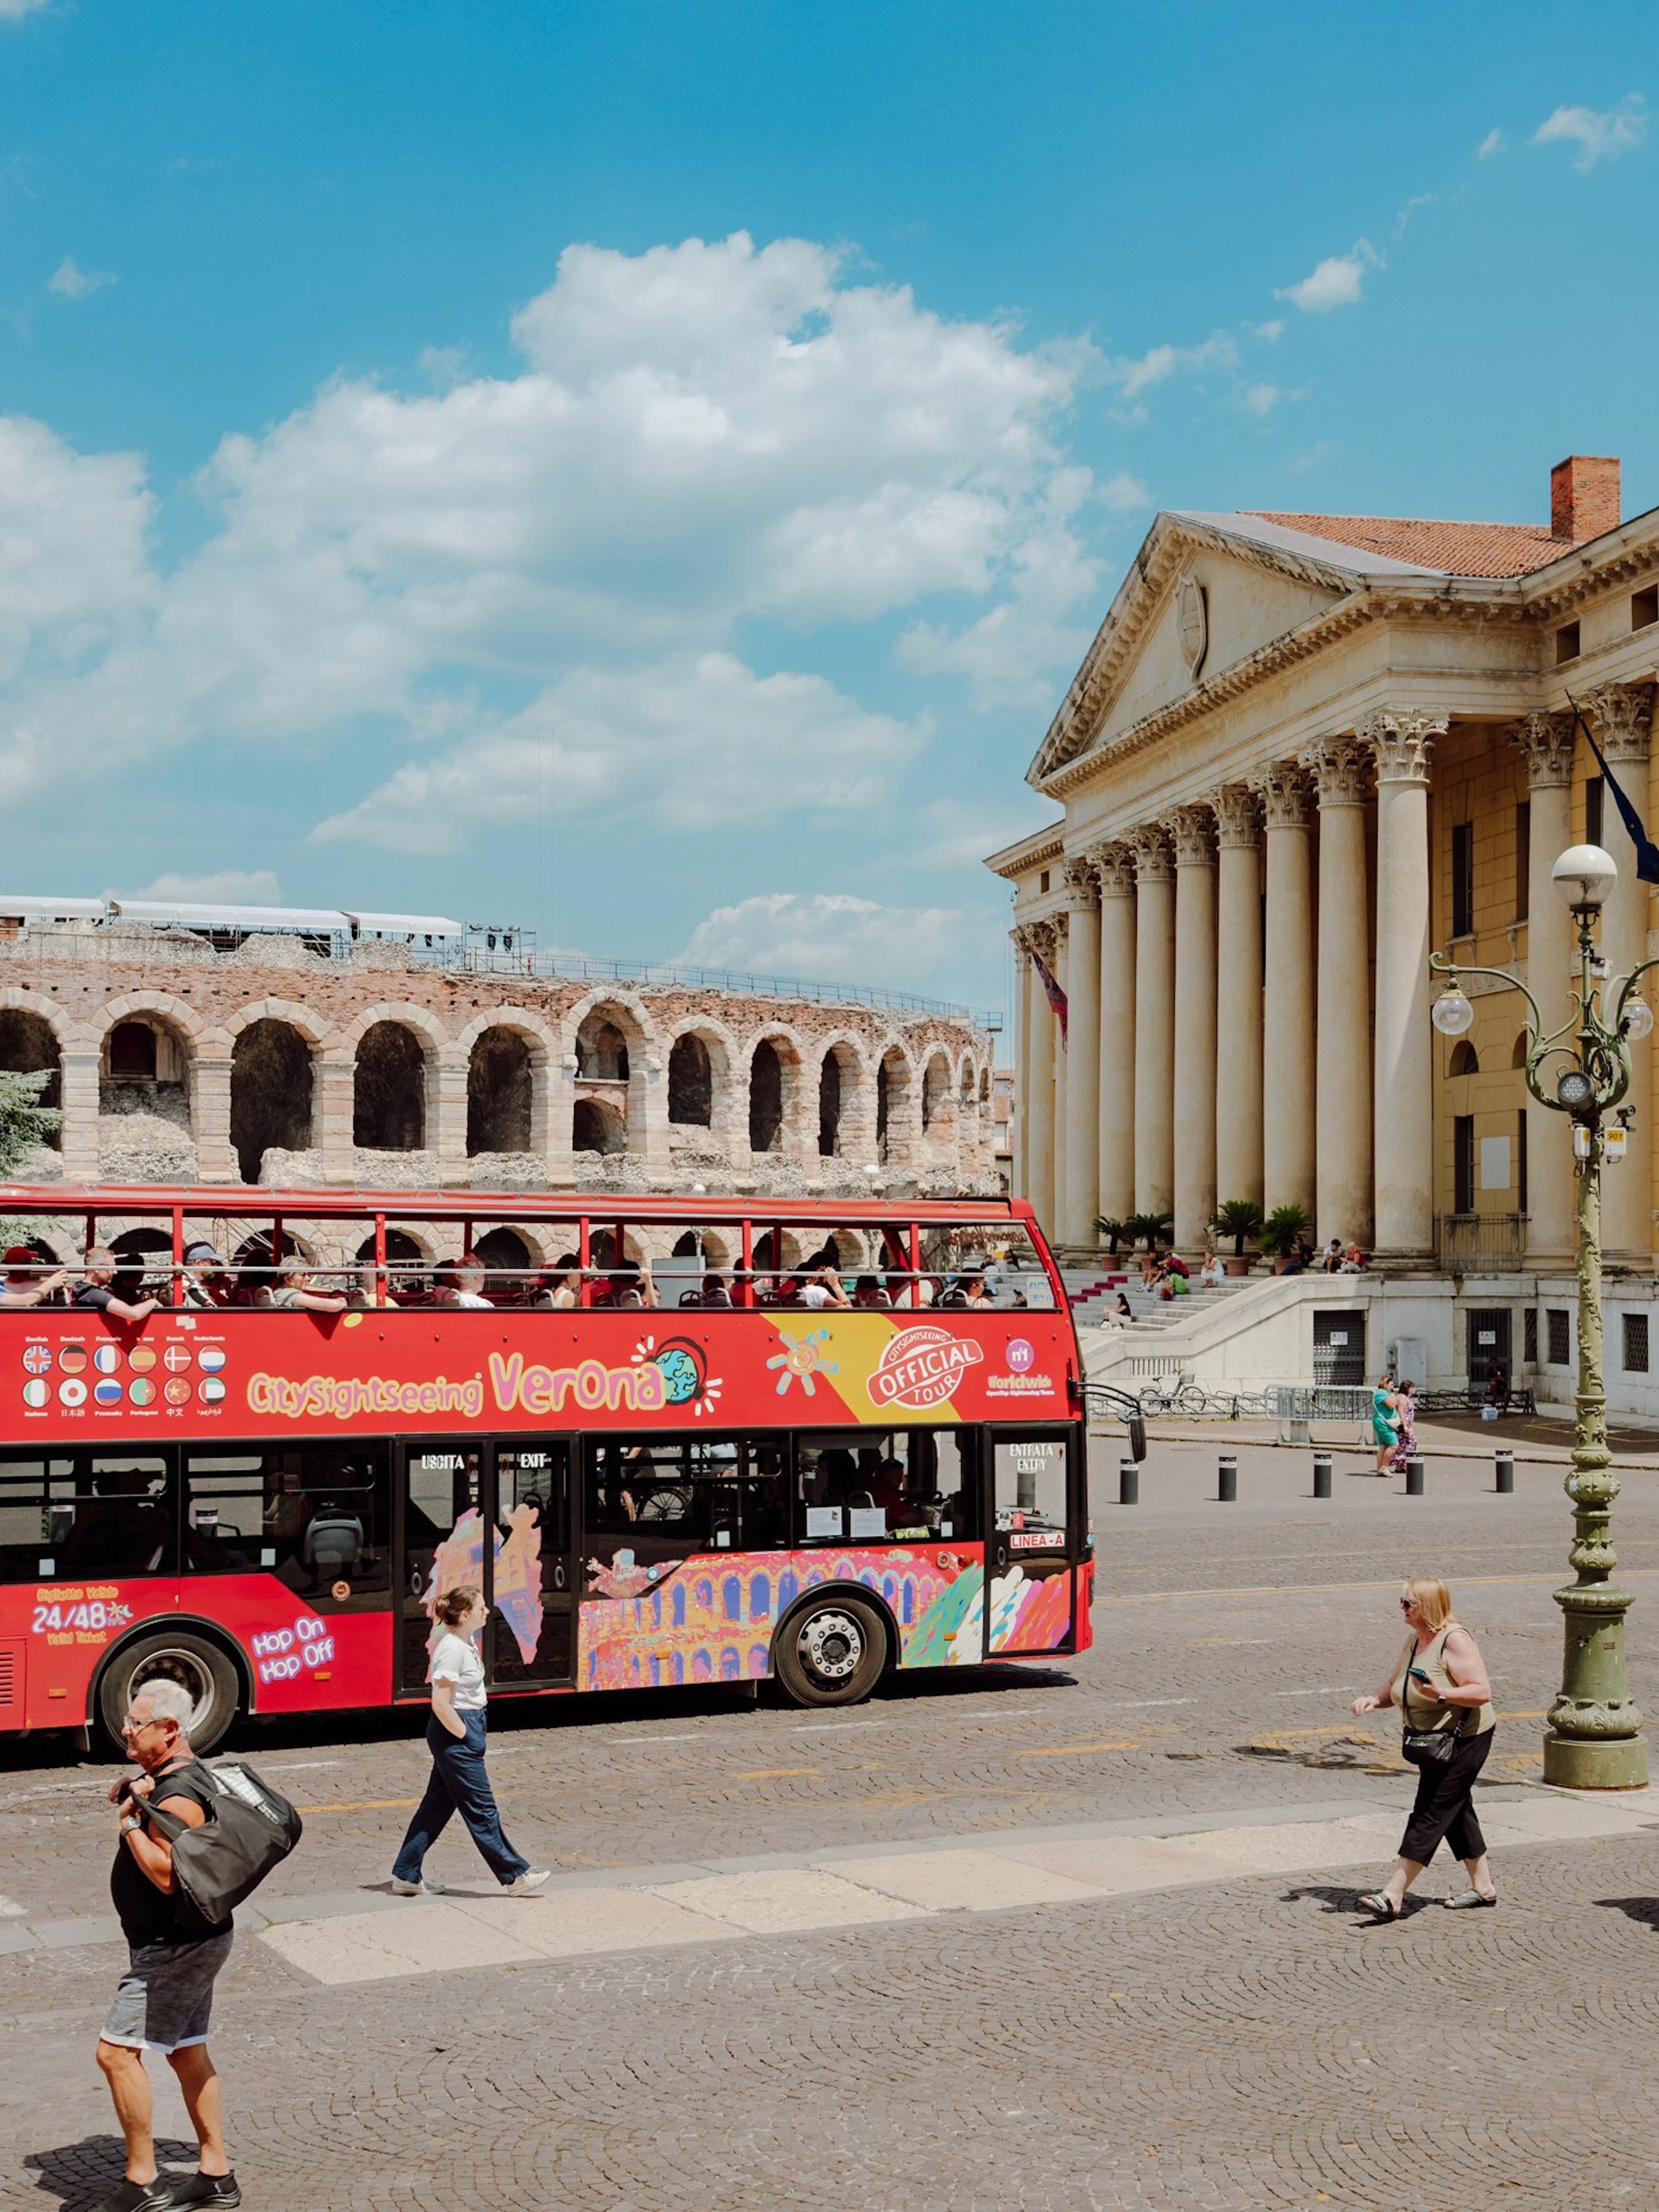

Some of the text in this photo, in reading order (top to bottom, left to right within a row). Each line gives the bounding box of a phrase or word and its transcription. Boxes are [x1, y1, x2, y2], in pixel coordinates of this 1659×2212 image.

[888, 1332, 946, 1361] CITYSIGHTSEEING
[879, 1344, 976, 1397] OFFICIAL
[488, 1352, 667, 1414] Verona
[913, 1375, 957, 1402] TOUR
[988, 1373, 1052, 1389] Worldwide
[60, 1408, 86, 1417] 日本語
[166, 1408, 184, 1417] 中文
[1010, 1443, 1053, 1456] ENTRATA
[421, 1455, 465, 1469] USCITA
[520, 1453, 547, 1468] EXIT
[1017, 1458, 1047, 1471] ENTRY
[1012, 1535, 1046, 1547] LINEA
[86, 1586, 119, 1599] Valido
[32, 1602, 106, 1634] 24/48
[295, 1618, 325, 1640] On
[47, 1631, 74, 1646] Valid
[303, 1637, 334, 1667] Off
